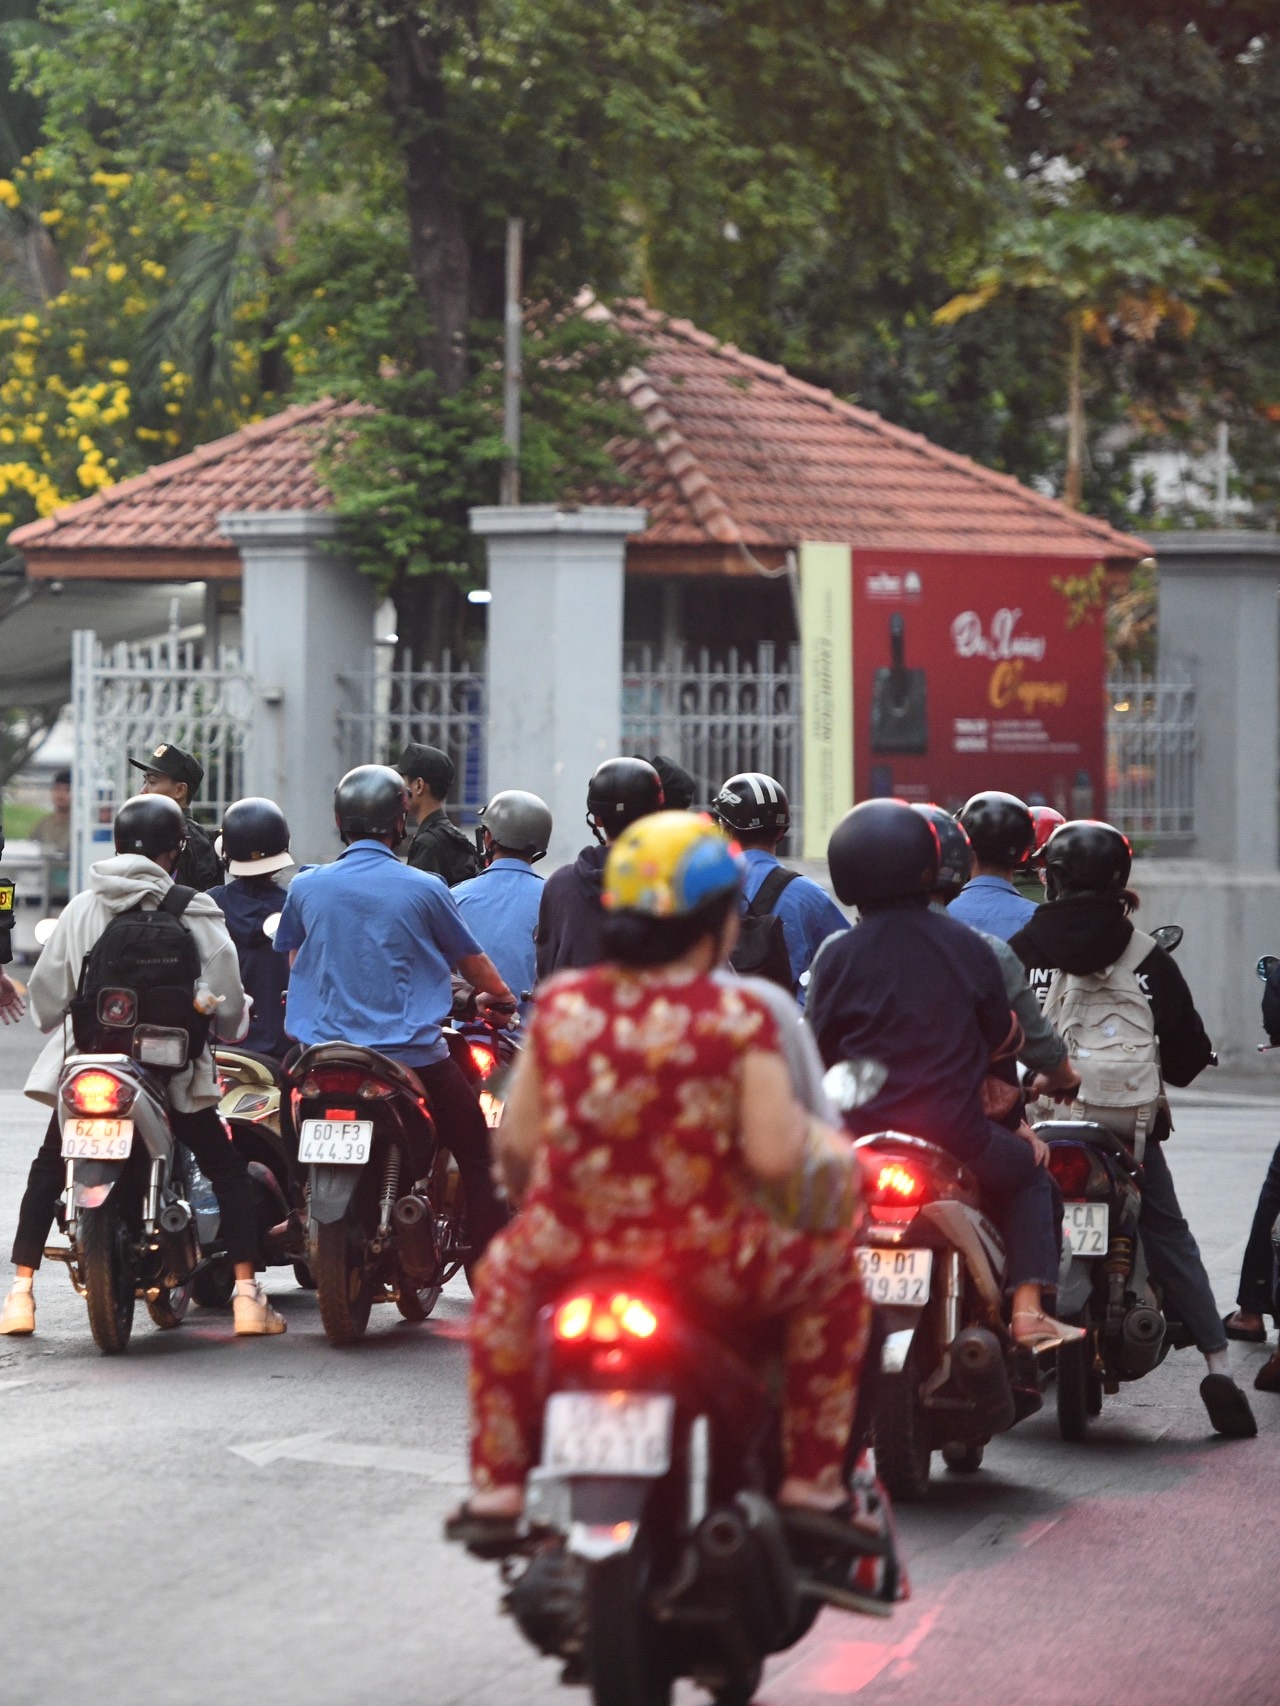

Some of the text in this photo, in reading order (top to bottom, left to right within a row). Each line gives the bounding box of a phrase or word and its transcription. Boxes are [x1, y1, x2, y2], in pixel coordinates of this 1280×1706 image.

[313, 1124, 361, 1141] 60-F3
[66, 1139, 128, 1156] 025.49
[304, 1142, 366, 1160] 444.39
